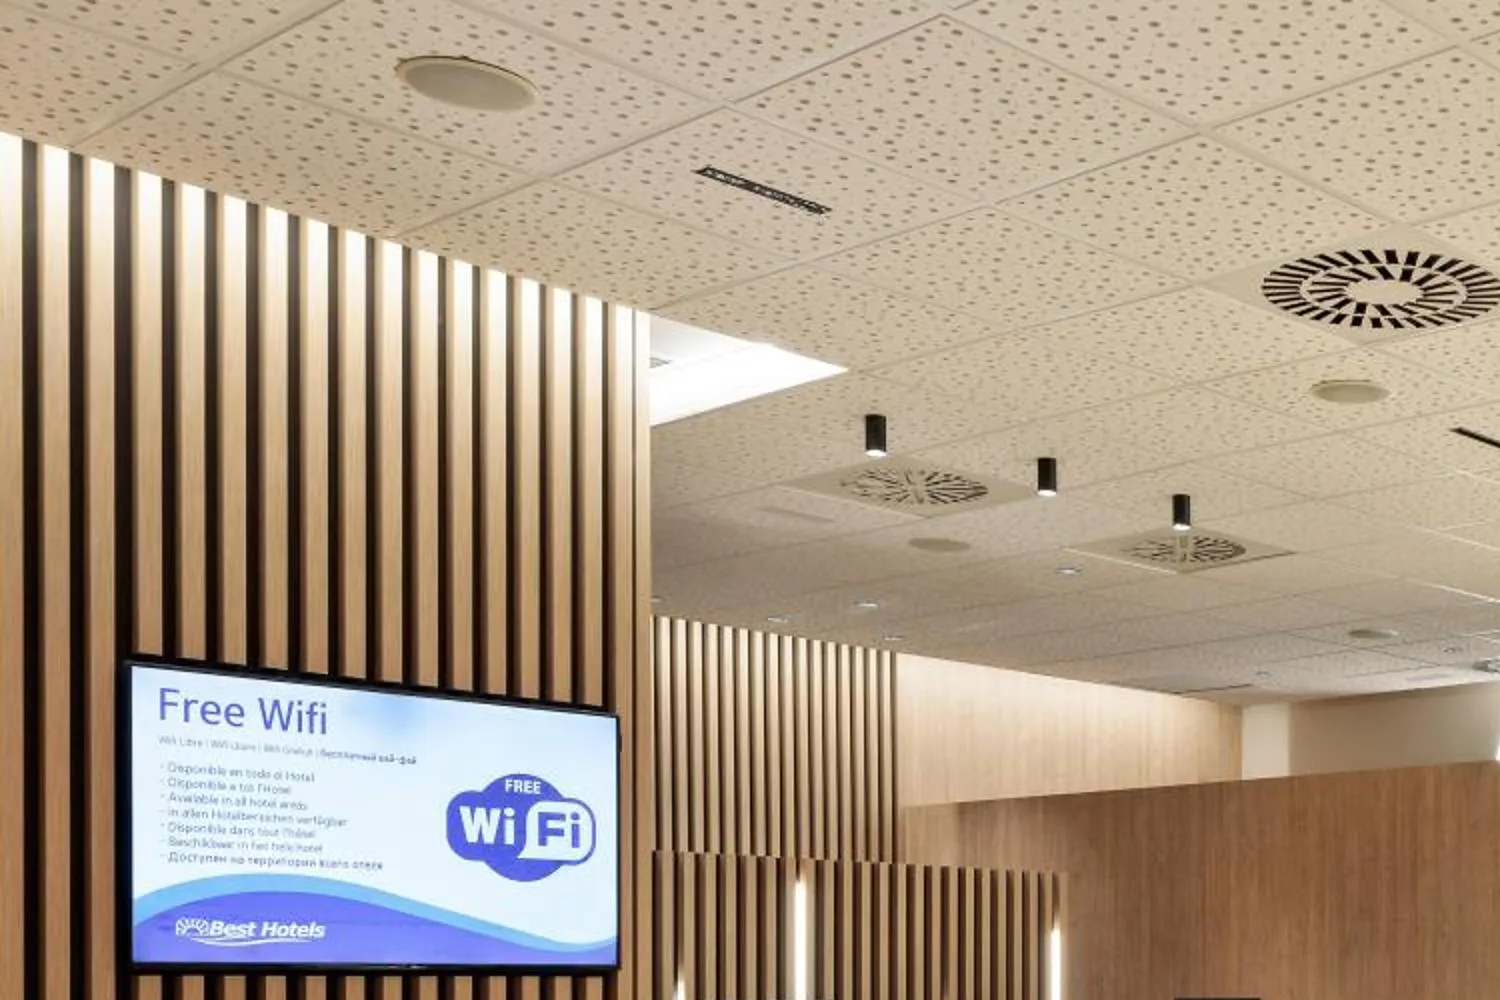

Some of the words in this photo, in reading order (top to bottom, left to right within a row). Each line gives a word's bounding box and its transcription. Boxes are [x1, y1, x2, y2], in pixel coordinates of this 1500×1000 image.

[160, 688, 245, 727] Free
[258, 697, 327, 735] Wifi
[505, 778, 542, 794] FREE
[210, 920, 257, 937] Best
[261, 920, 326, 938] Hotels
